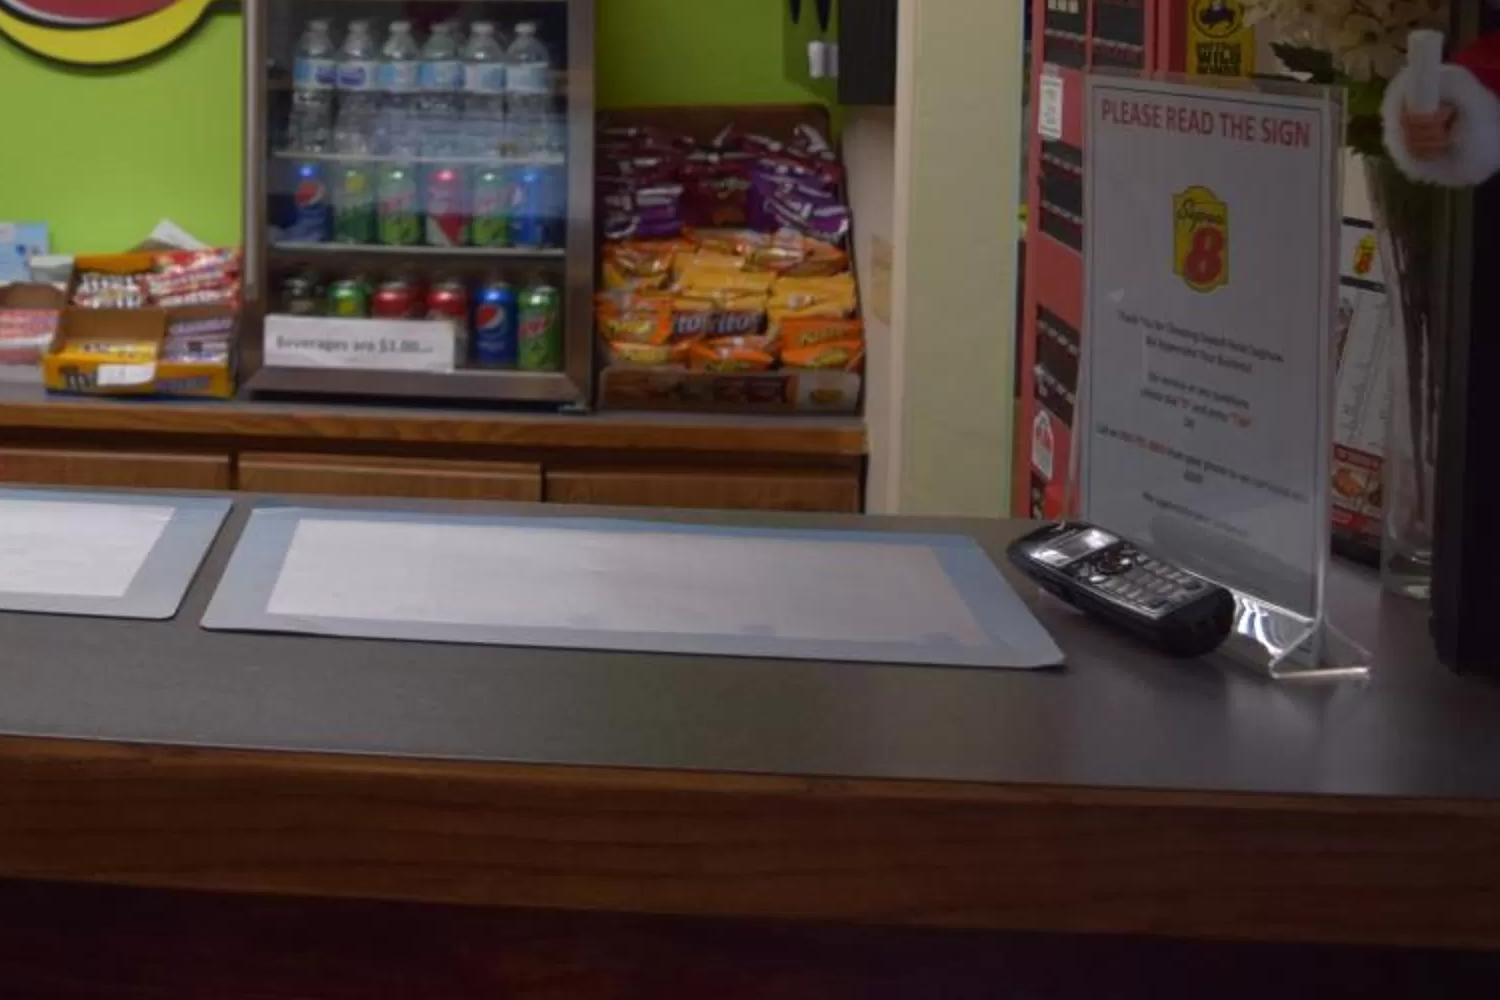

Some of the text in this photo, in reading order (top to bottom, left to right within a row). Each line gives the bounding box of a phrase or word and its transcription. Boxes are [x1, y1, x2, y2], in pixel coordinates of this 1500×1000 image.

[1100, 98, 1311, 149] PLEASE READ THE SIGN
[1183, 224, 1224, 285] 8
[275, 335, 349, 352] Beverages
[353, 340, 375, 352] are
